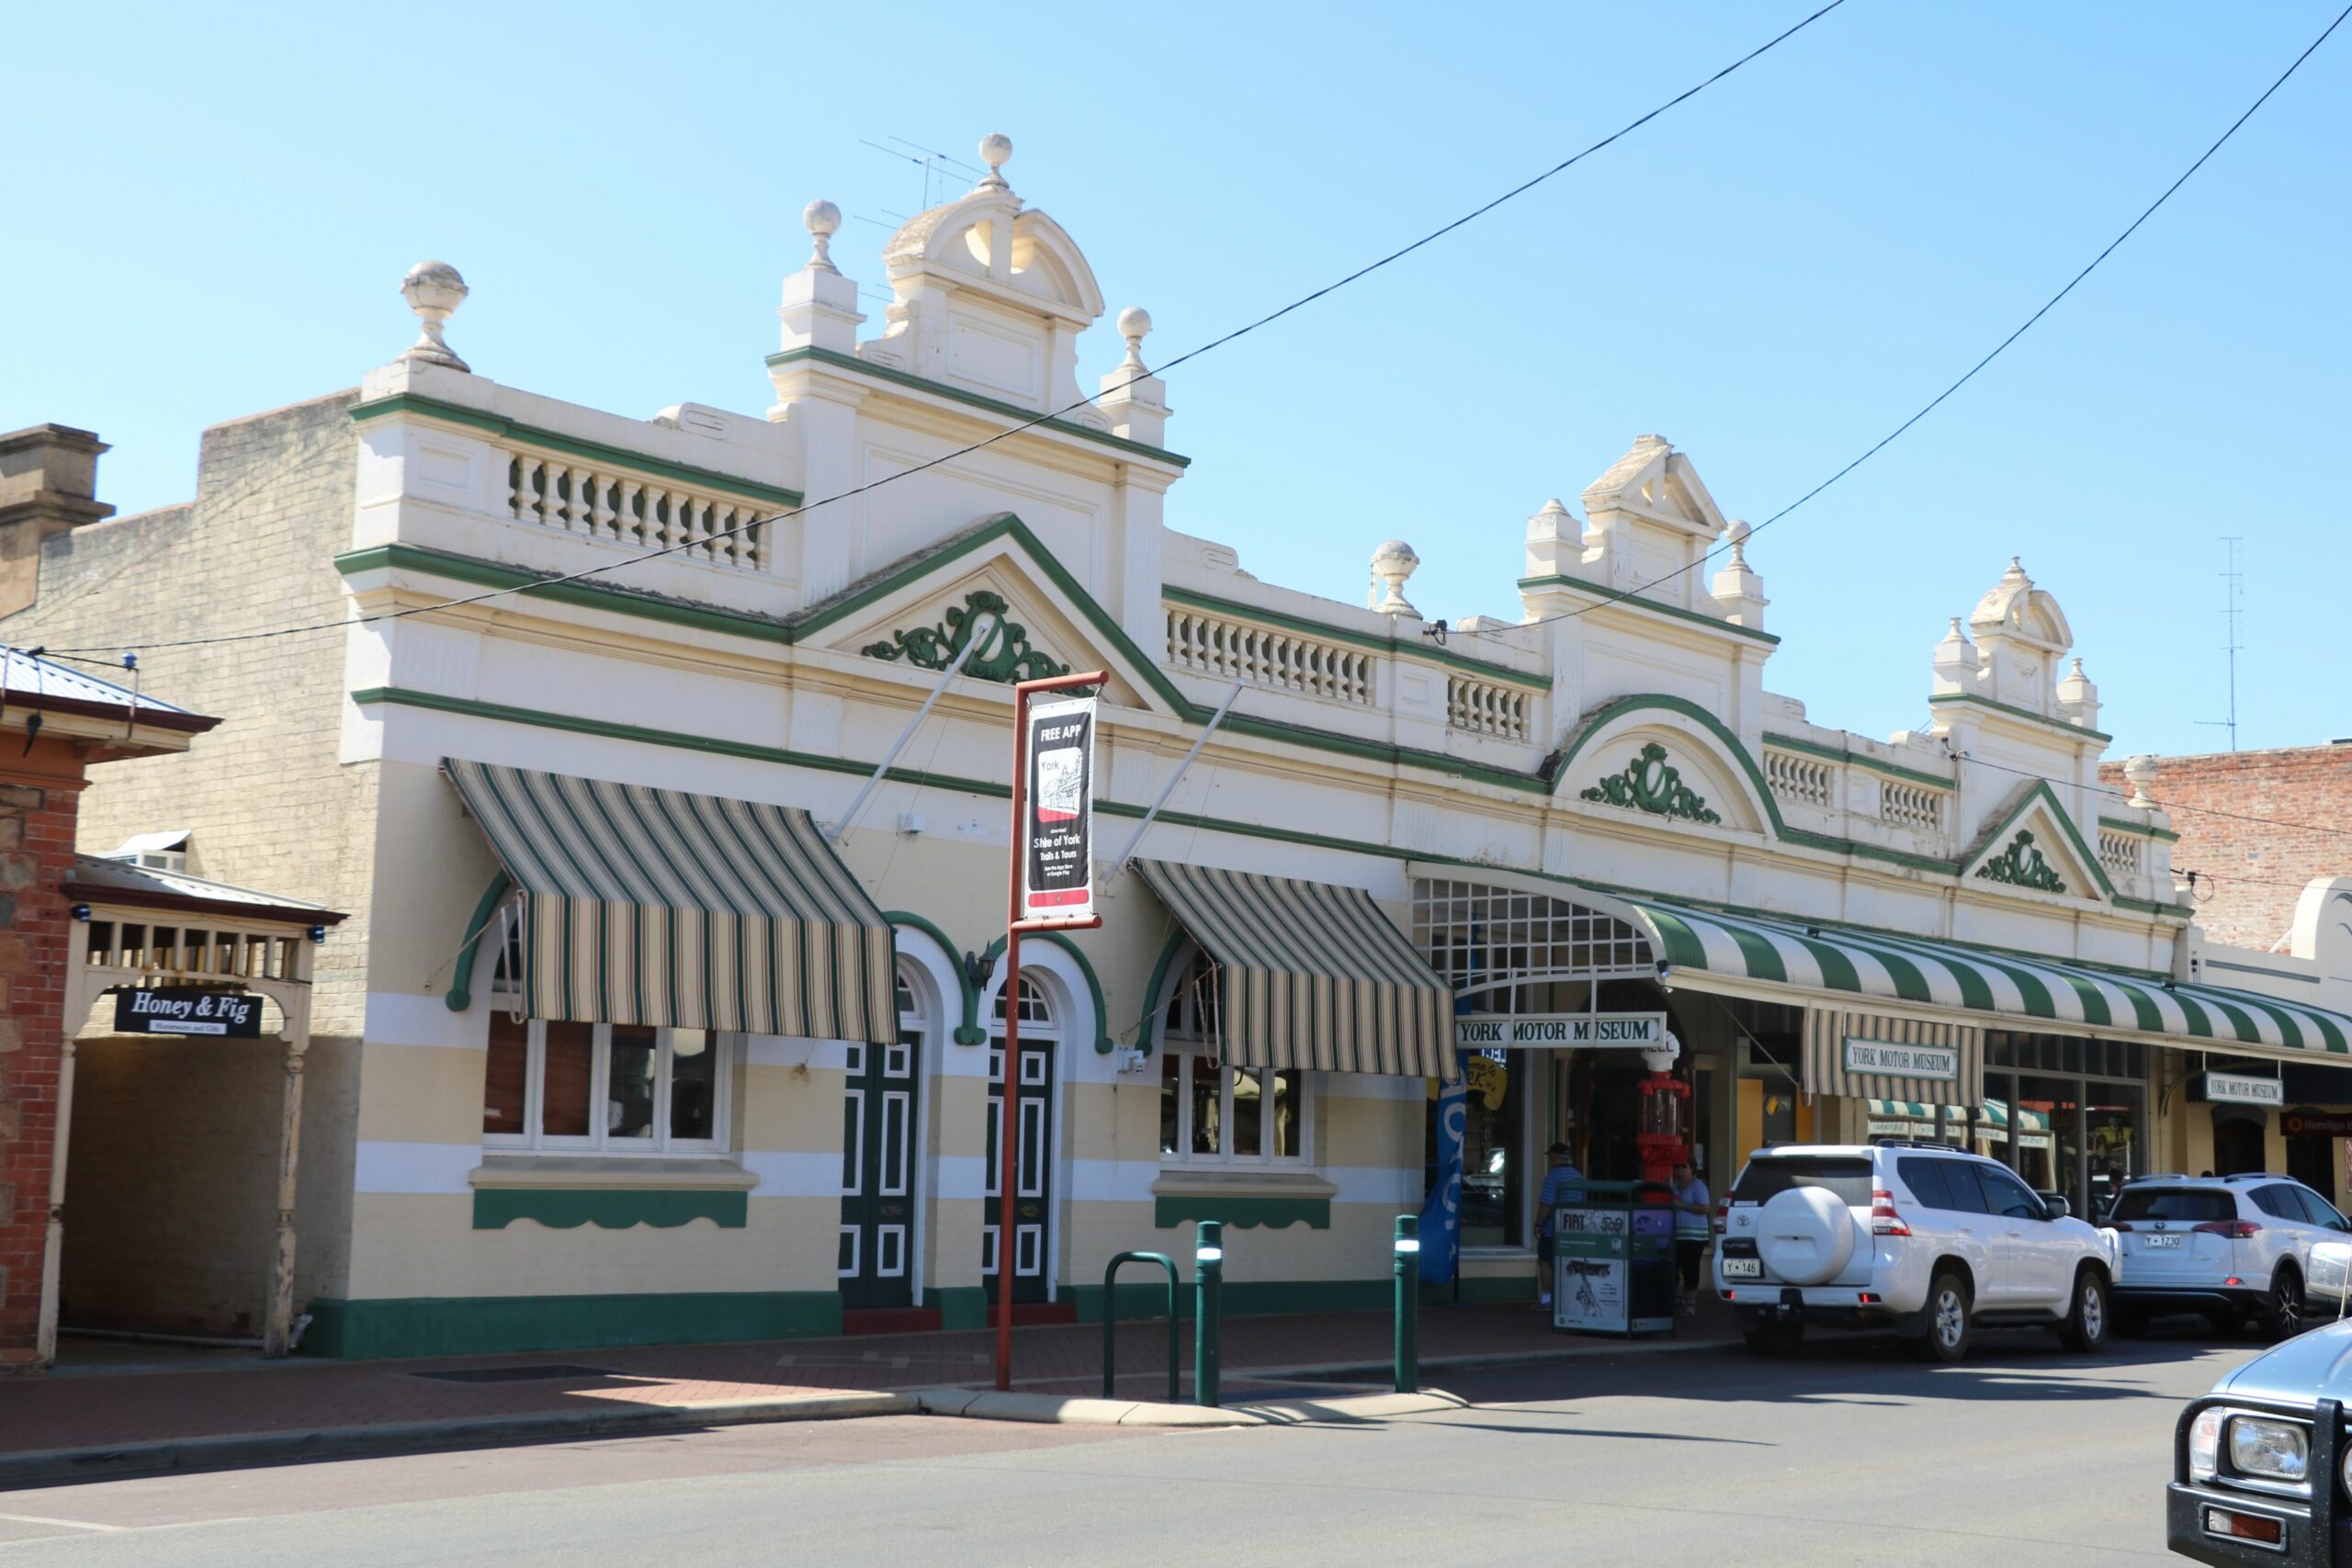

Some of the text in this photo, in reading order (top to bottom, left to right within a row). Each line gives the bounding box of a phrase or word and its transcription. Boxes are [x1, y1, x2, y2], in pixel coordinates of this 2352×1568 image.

[1041, 724, 1081, 741] FREE APP
[1041, 759, 1059, 772] York
[1034, 833, 1081, 848] Shire of York
[1055, 851, 1060, 860] &
[1061, 850, 1077, 859] Tours
[131, 992, 250, 1024] Honey & Fig
[1461, 1023, 1502, 1042] YORK
[1513, 1021, 1566, 1041] MOTOR
[1853, 1046, 1951, 1072] YORK MOTOR MUSEUM
[2211, 1079, 2278, 1100] YORK MOTOR MUSEUM
[2304, 1120, 2345, 1131] Bendigo
[1563, 1213, 1586, 1230] FIAT
[1742, 1263, 1756, 1273] 146
